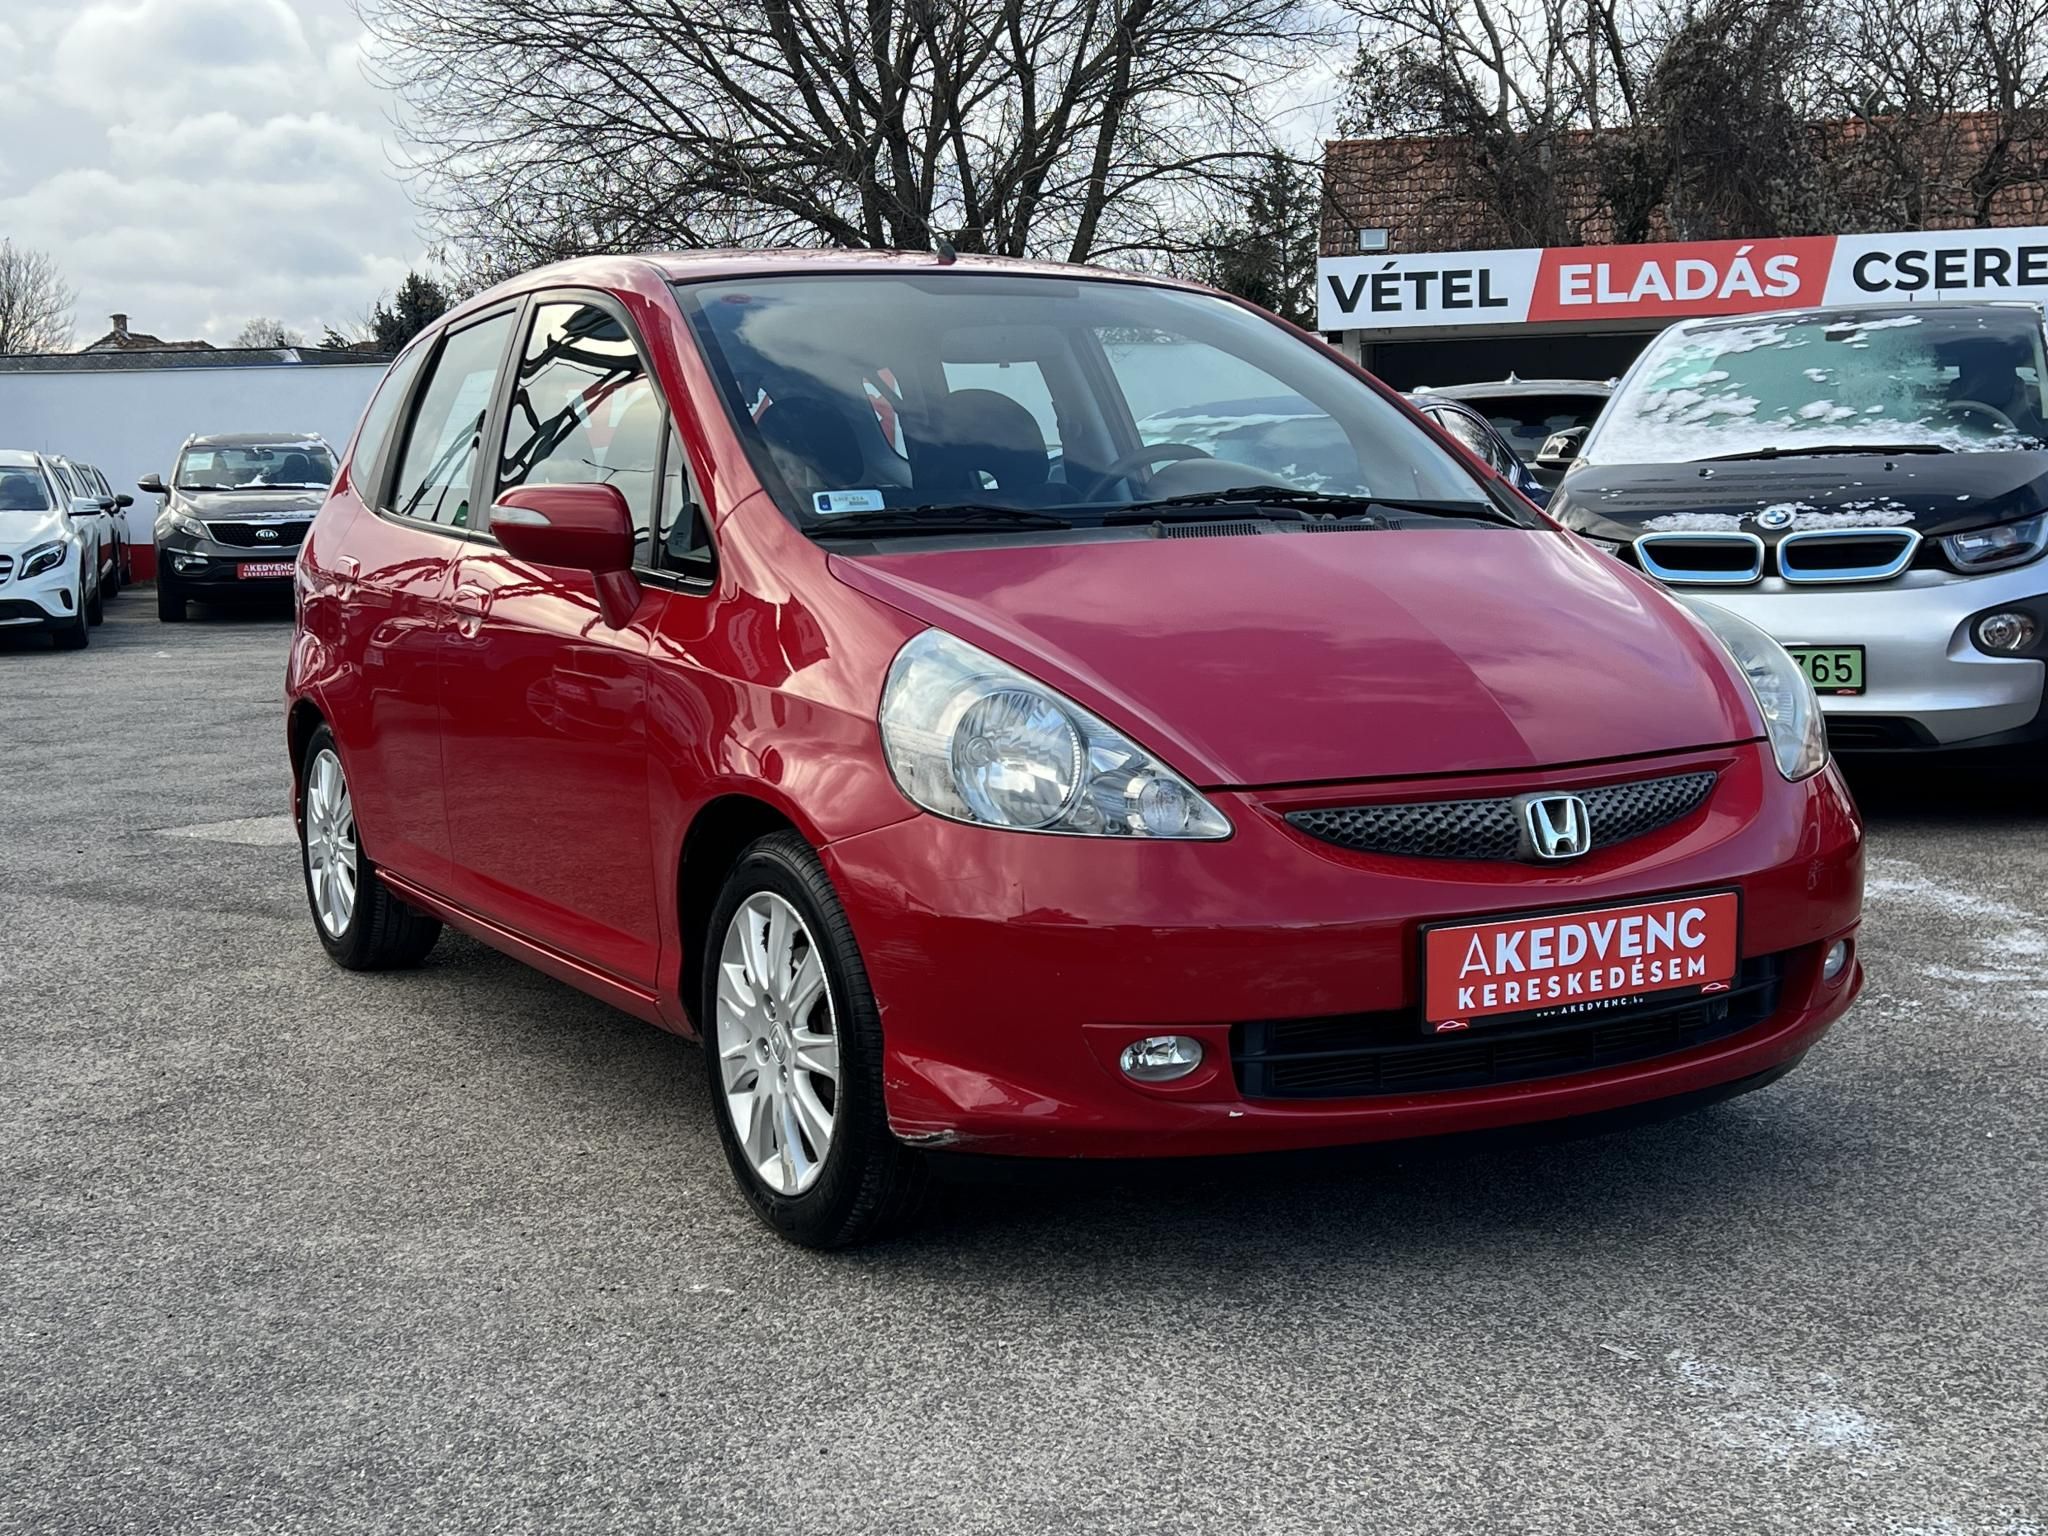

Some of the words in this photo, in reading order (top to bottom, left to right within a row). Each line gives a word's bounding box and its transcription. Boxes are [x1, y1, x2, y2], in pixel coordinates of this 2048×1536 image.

[1327, 262, 1508, 314] VÉTEL
[1559, 245, 1800, 306] ELADÁS
[1852, 245, 2048, 292] CSERE
[259, 530, 275, 538] KIA
[243, 563, 294, 572] AKEDVENC
[1459, 907, 1707, 980] AKEDVENC
[1458, 954, 1706, 1010] KERESKEDÉSEM
